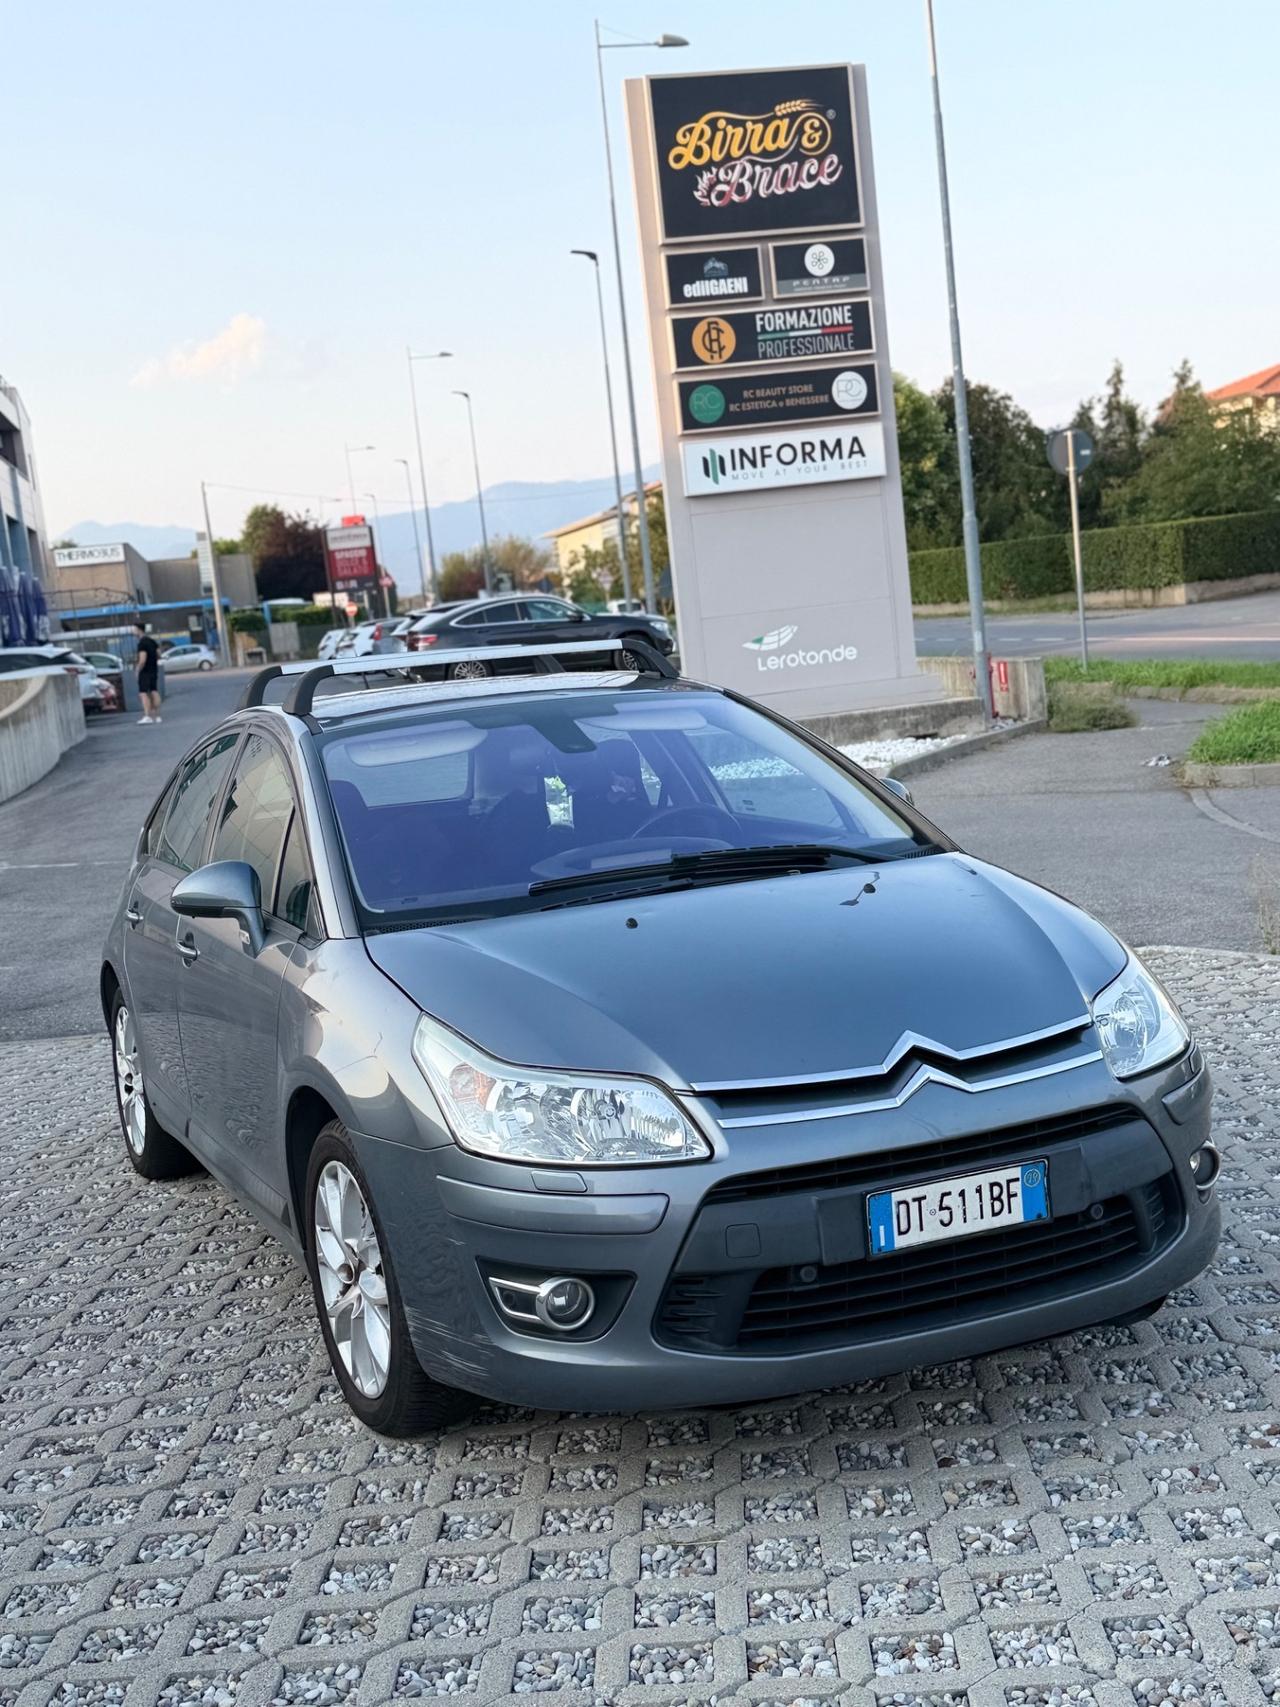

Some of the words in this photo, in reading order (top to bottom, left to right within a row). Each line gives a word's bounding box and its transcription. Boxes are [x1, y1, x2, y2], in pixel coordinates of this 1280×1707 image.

[668, 114, 791, 170] Birra
[709, 154, 843, 207] Brace
[755, 305, 852, 332] FORMAZIONE
[758, 333, 854, 358] PROFESSIONALE
[729, 403, 740, 411] RC
[742, 400, 777, 411] ESTETICA
[785, 394, 829, 406] BENESSERE
[743, 390, 754, 398] RC
[755, 387, 786, 397] BEAUTY
[788, 384, 813, 394] STORE
[730, 436, 866, 471] INFORMA
[731, 471, 765, 480] MOVE
[774, 469, 787, 477] AT
[797, 465, 828, 475] YOUR
[840, 460, 868, 470] BEST
[757, 644, 857, 671] Lerotonde
[896, 1195, 926, 1236] DT
[938, 1177, 1020, 1227] 511BF
